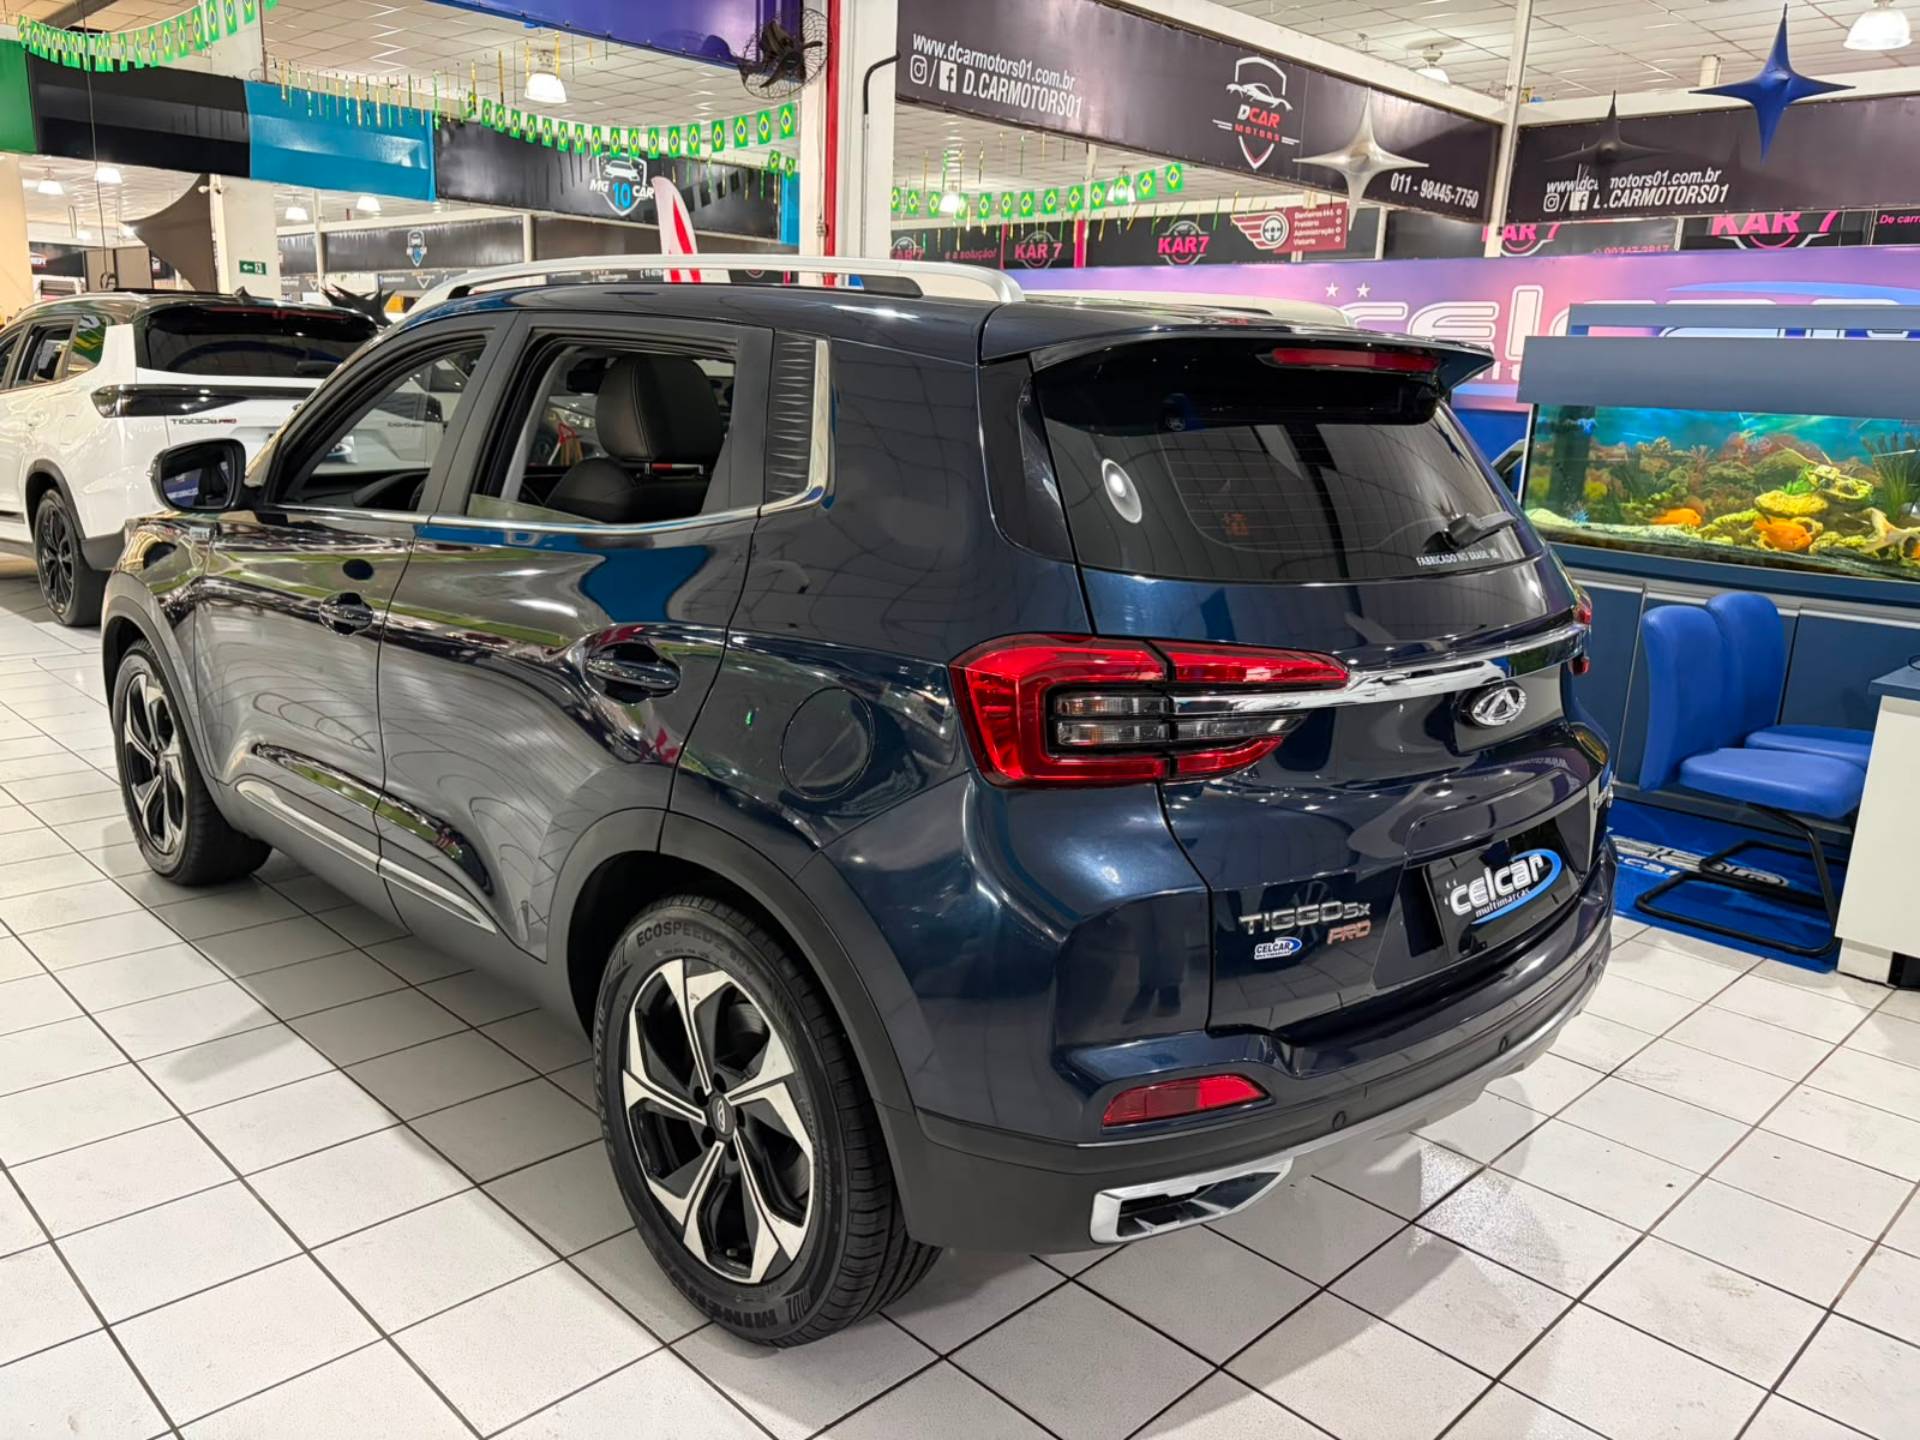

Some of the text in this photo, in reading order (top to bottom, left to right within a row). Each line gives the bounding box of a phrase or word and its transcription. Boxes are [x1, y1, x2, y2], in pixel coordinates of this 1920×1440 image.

[913, 33, 1075, 91] www.dcarmotors01.com.br
[962, 69, 1083, 119] D.CARMOTORS01
[1237, 104, 1281, 128] DCAR
[1234, 123, 1280, 142] MOTORS
[589, 179, 610, 193] MG
[613, 182, 632, 209] 10
[632, 185, 655, 199] CAR
[1390, 172, 1412, 194] 011
[1420, 178, 1479, 208] 98445-7750
[1014, 242, 1049, 259] KAR
[1450, 853, 1545, 916] celcar
[1475, 887, 1531, 917] multimarcas
[1327, 919, 1372, 945] PRO
